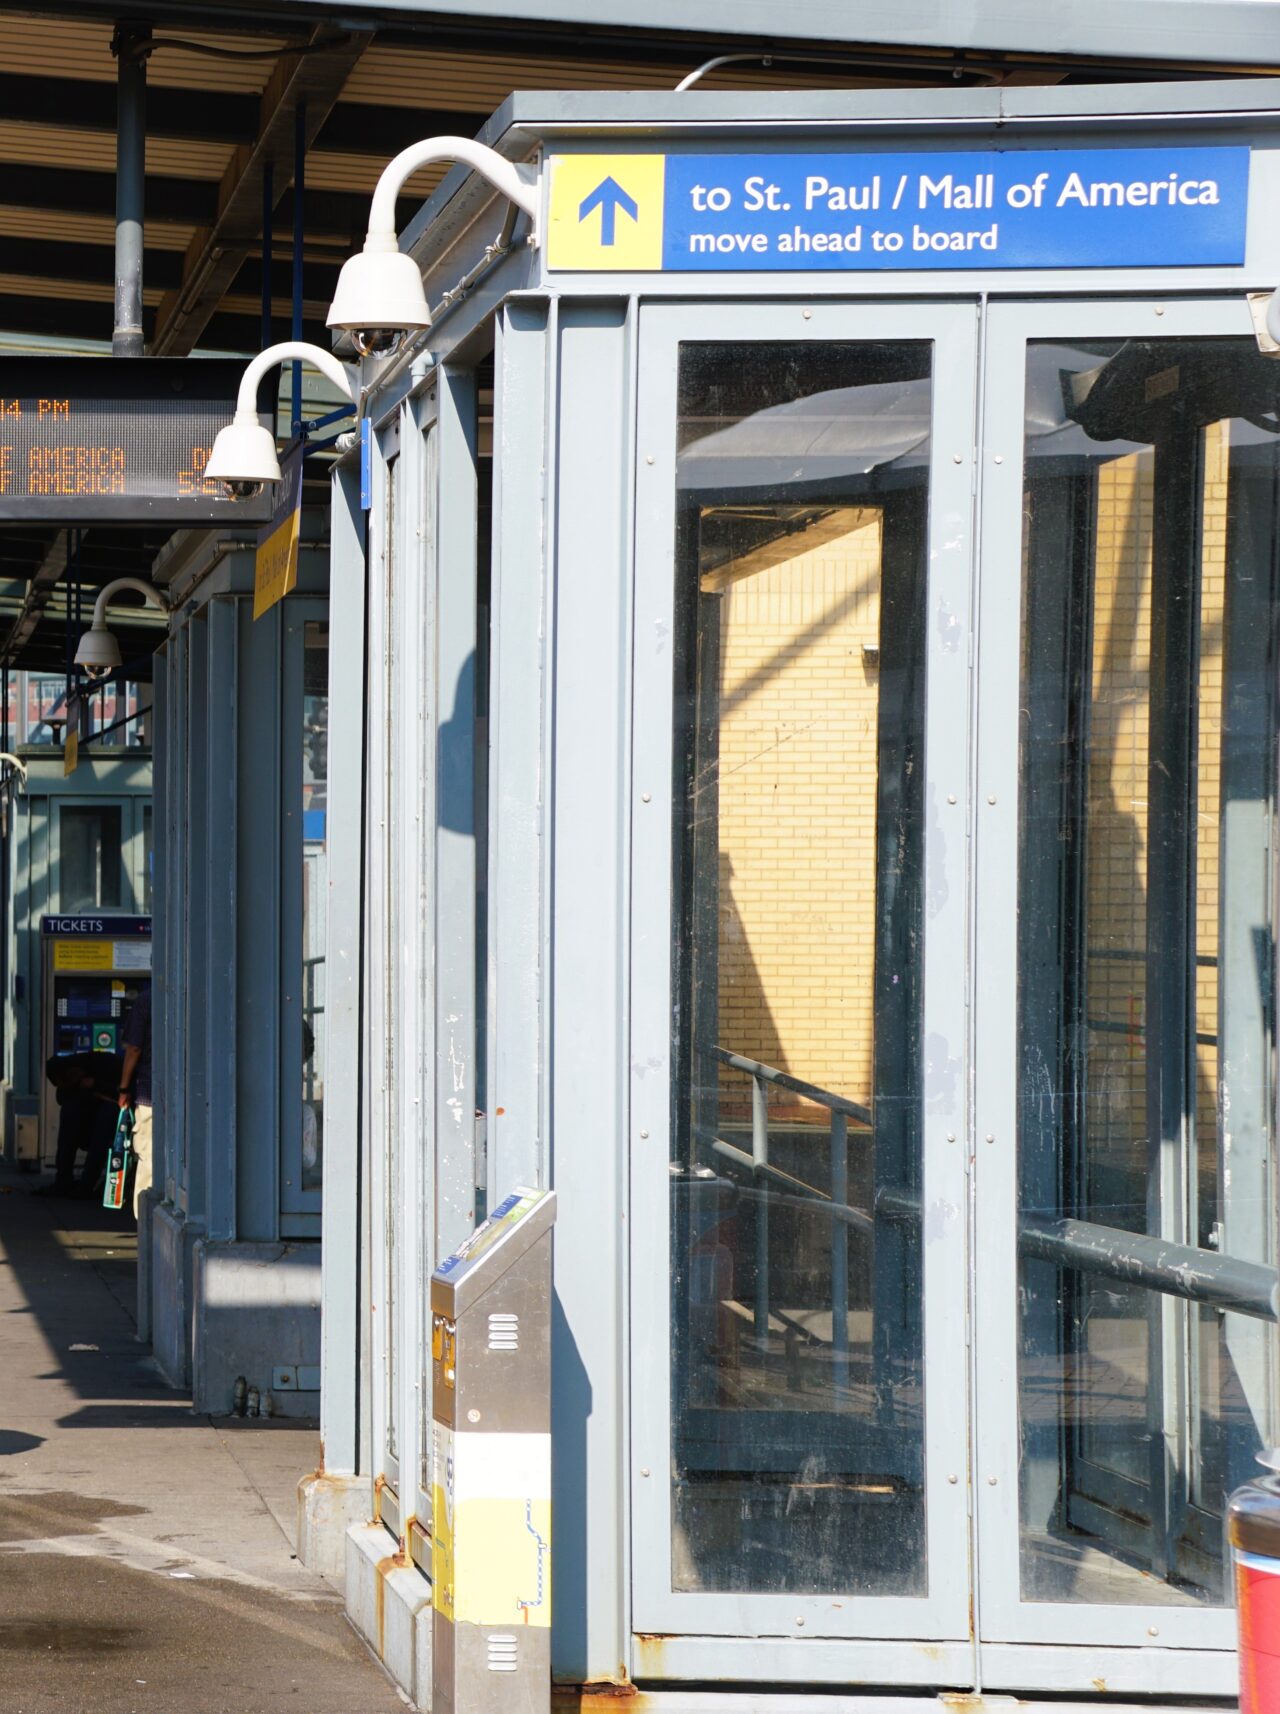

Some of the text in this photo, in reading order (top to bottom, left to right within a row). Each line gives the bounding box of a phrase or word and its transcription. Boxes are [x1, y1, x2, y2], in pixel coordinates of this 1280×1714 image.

[689, 183, 731, 211] to
[743, 176, 791, 211] St.
[805, 175, 880, 211] Paul
[918, 174, 993, 209] Mall
[1006, 173, 1049, 208] of
[1056, 172, 1220, 208] America
[689, 224, 998, 253] move ahead to board
[38, 399, 70, 421] PM
[29, 447, 125, 469] AMERICA
[29, 471, 125, 494] AMERICA
[48, 919, 103, 932] TICKETS
